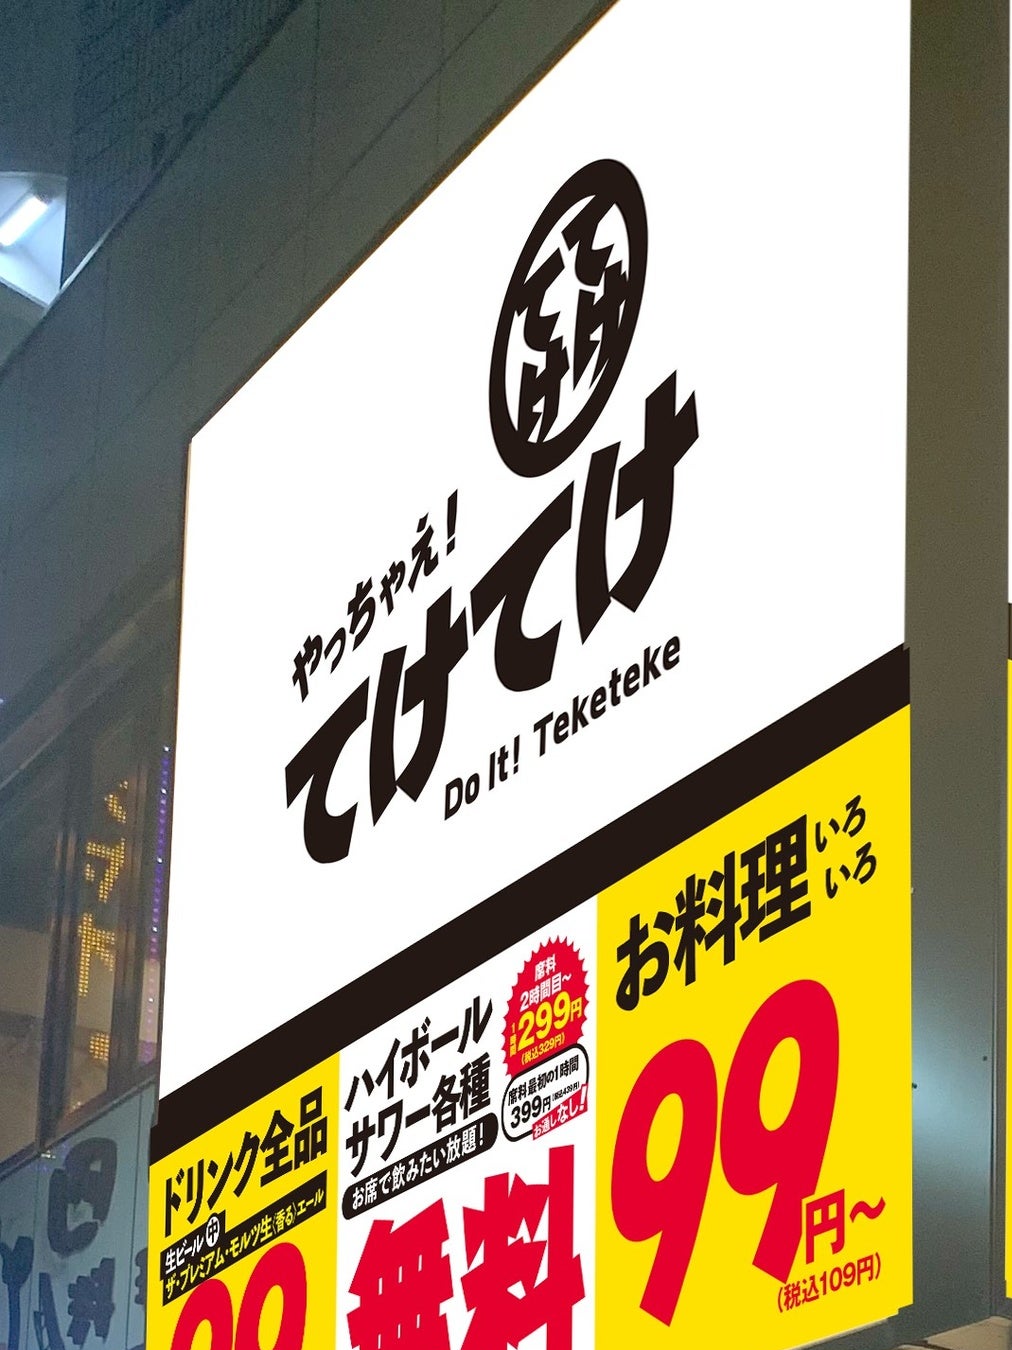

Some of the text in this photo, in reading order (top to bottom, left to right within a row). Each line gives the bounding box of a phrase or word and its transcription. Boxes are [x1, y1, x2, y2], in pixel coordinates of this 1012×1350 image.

[285, 370, 699, 864] てけてけ
[292, 489, 458, 702] やっちゃえ!
[444, 631, 682, 820] Do It! Teketeke
[615, 815, 811, 1011] お料理
[343, 995, 493, 1113] ハイボール
[345, 1052, 492, 1178] サワー各種
[165, 1085, 328, 1237] ドリンク全品
[352, 1126, 485, 1211] お席で飲みたい放題!
[777, 1252, 881, 1312] (税込109円)
